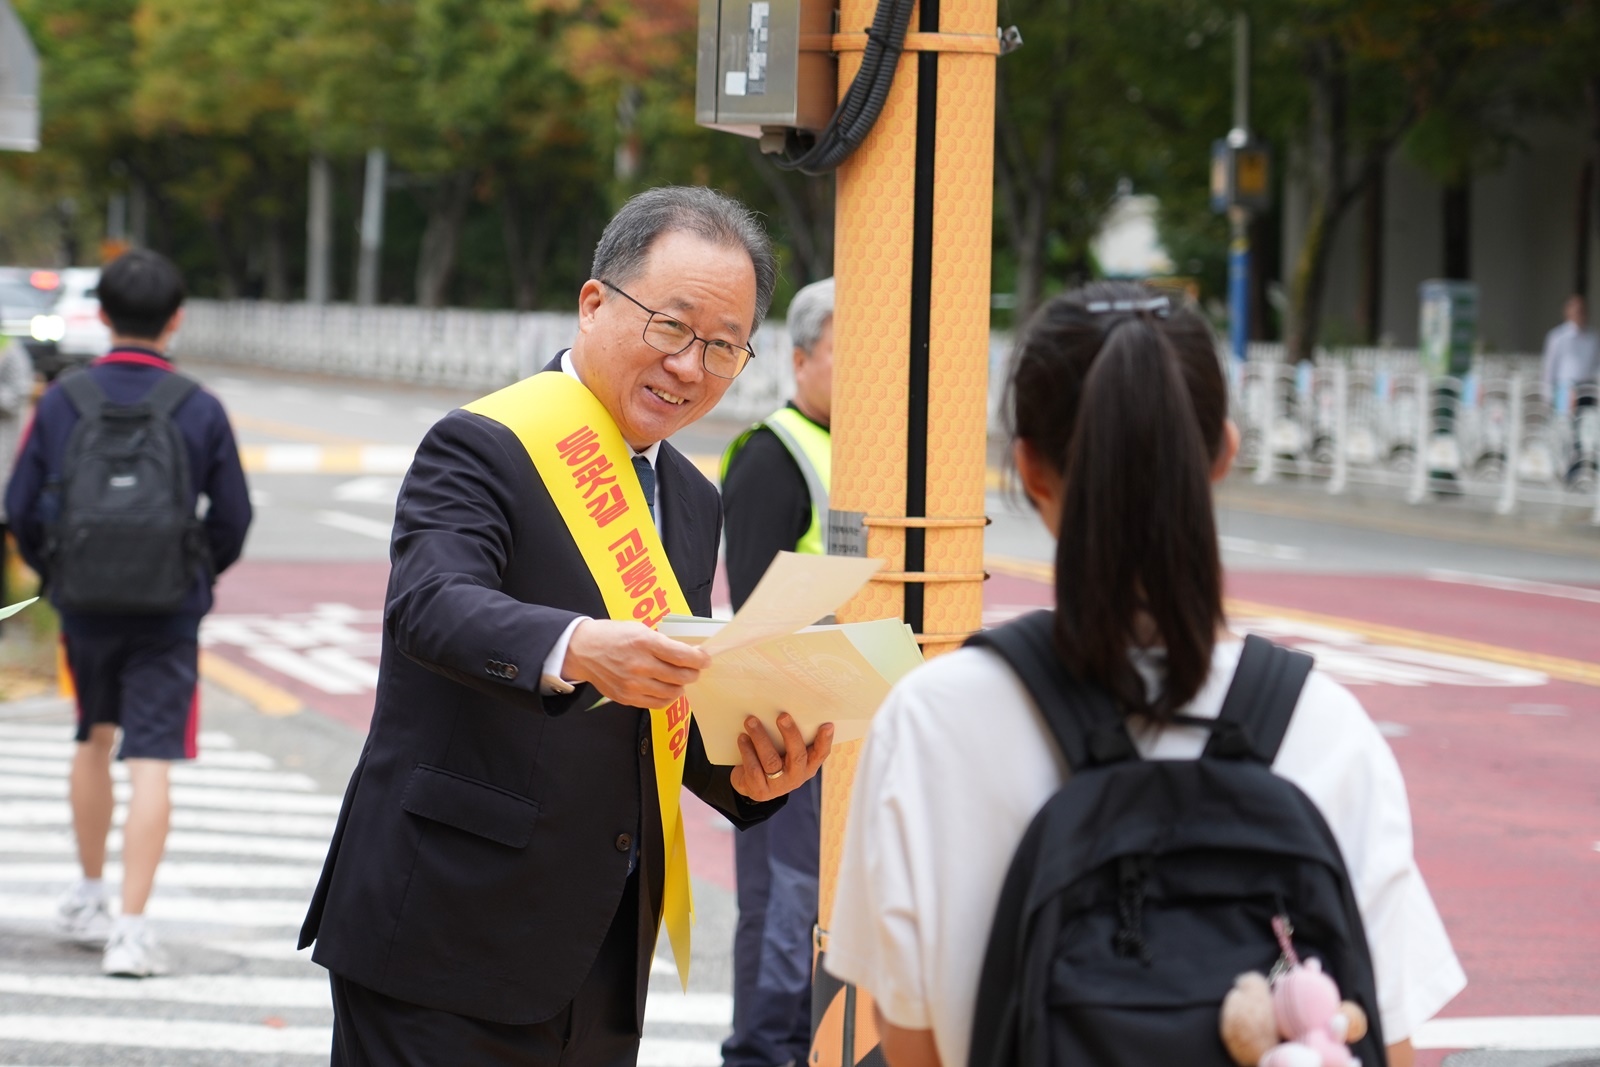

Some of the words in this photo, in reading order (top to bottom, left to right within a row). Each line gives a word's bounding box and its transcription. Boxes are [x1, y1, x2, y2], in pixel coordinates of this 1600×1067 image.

[556, 425, 630, 528] 등굣길
[608, 528, 671, 632] 교통안
[665, 694, 690, 761] 페인
